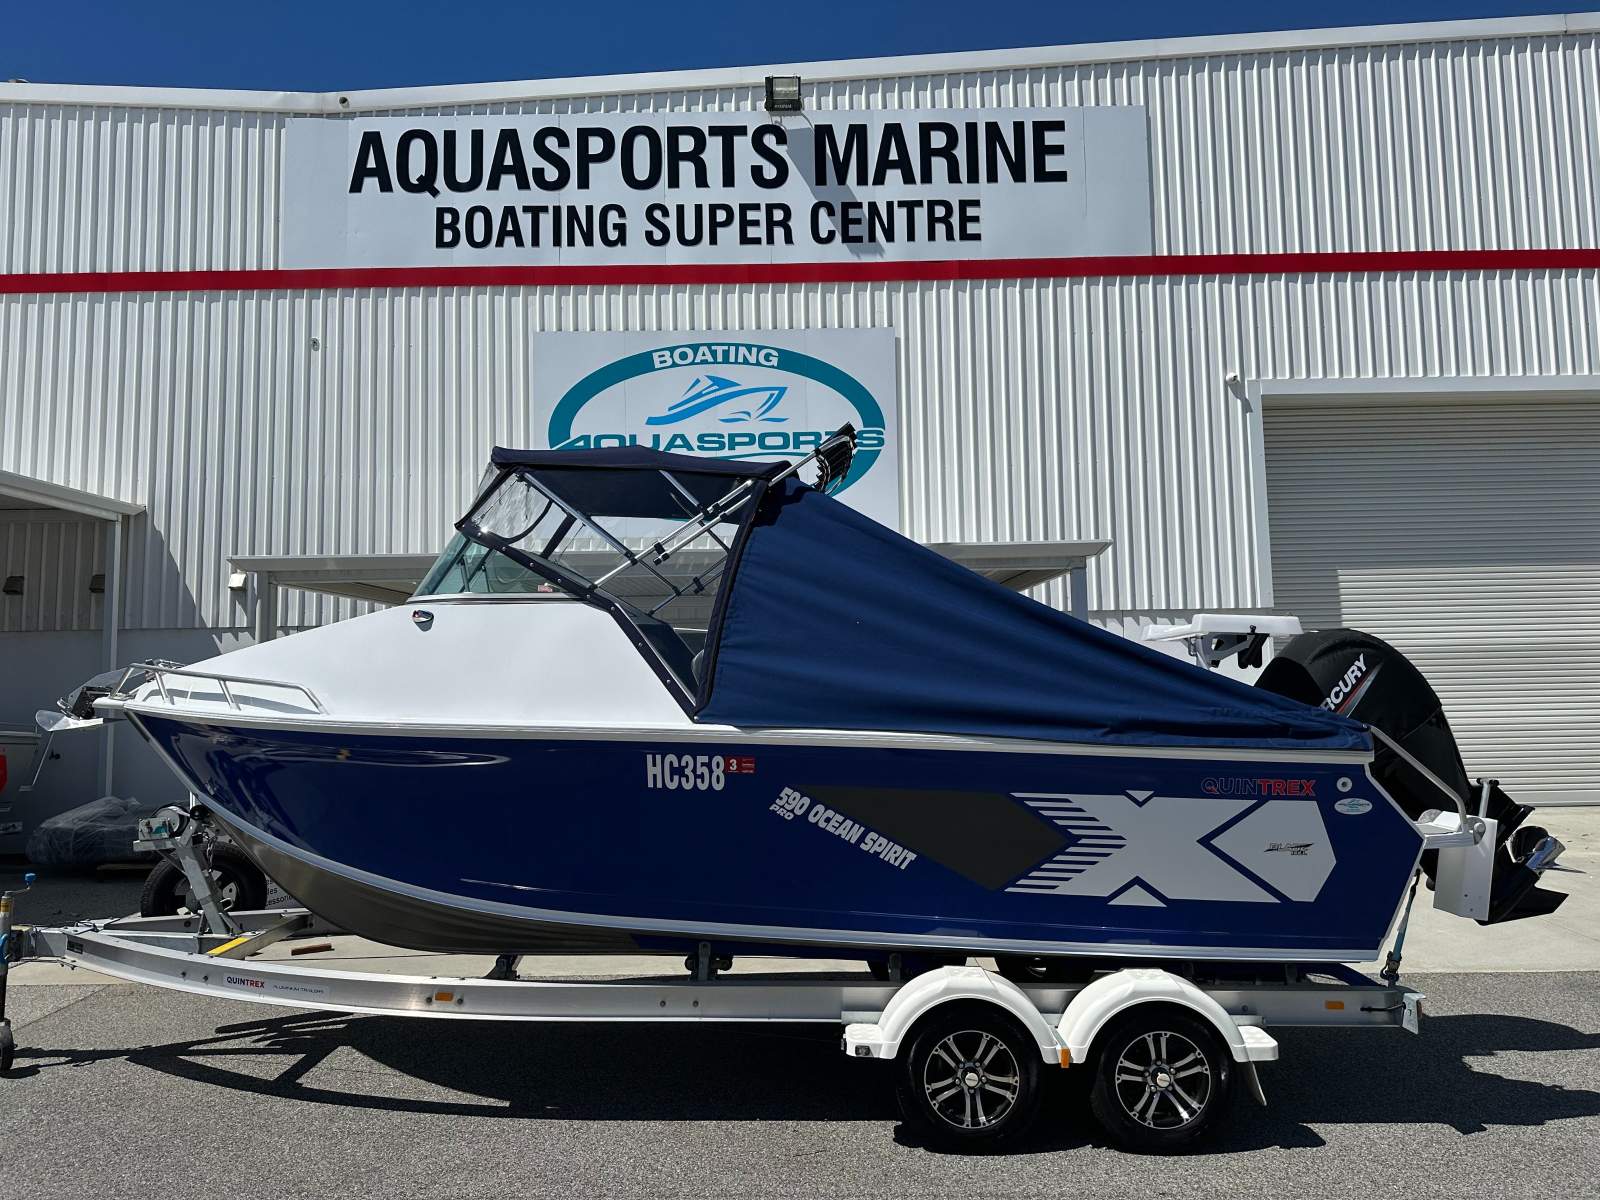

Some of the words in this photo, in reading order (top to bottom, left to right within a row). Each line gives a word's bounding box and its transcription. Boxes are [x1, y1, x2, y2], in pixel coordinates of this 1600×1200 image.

[349, 125, 789, 200] AQUASPORTS
[814, 119, 1069, 187] MARINE
[435, 203, 628, 249] BOATING
[644, 202, 794, 247] SUPER
[810, 199, 982, 244] CENTRE
[652, 345, 780, 370] BOATING
[562, 428, 885, 452] AQUASPORS
[1320, 652, 1367, 711] RCURY
[646, 753, 726, 791] HC358
[729, 758, 738, 771] 3
[1201, 777, 1317, 797] QUINTREX
[769, 804, 795, 821] PRO
[775, 786, 811, 816] 590
[807, 803, 866, 845] OCEAN
[859, 831, 918, 871] SPIRIT
[226, 976, 265, 989] QUINTREX
